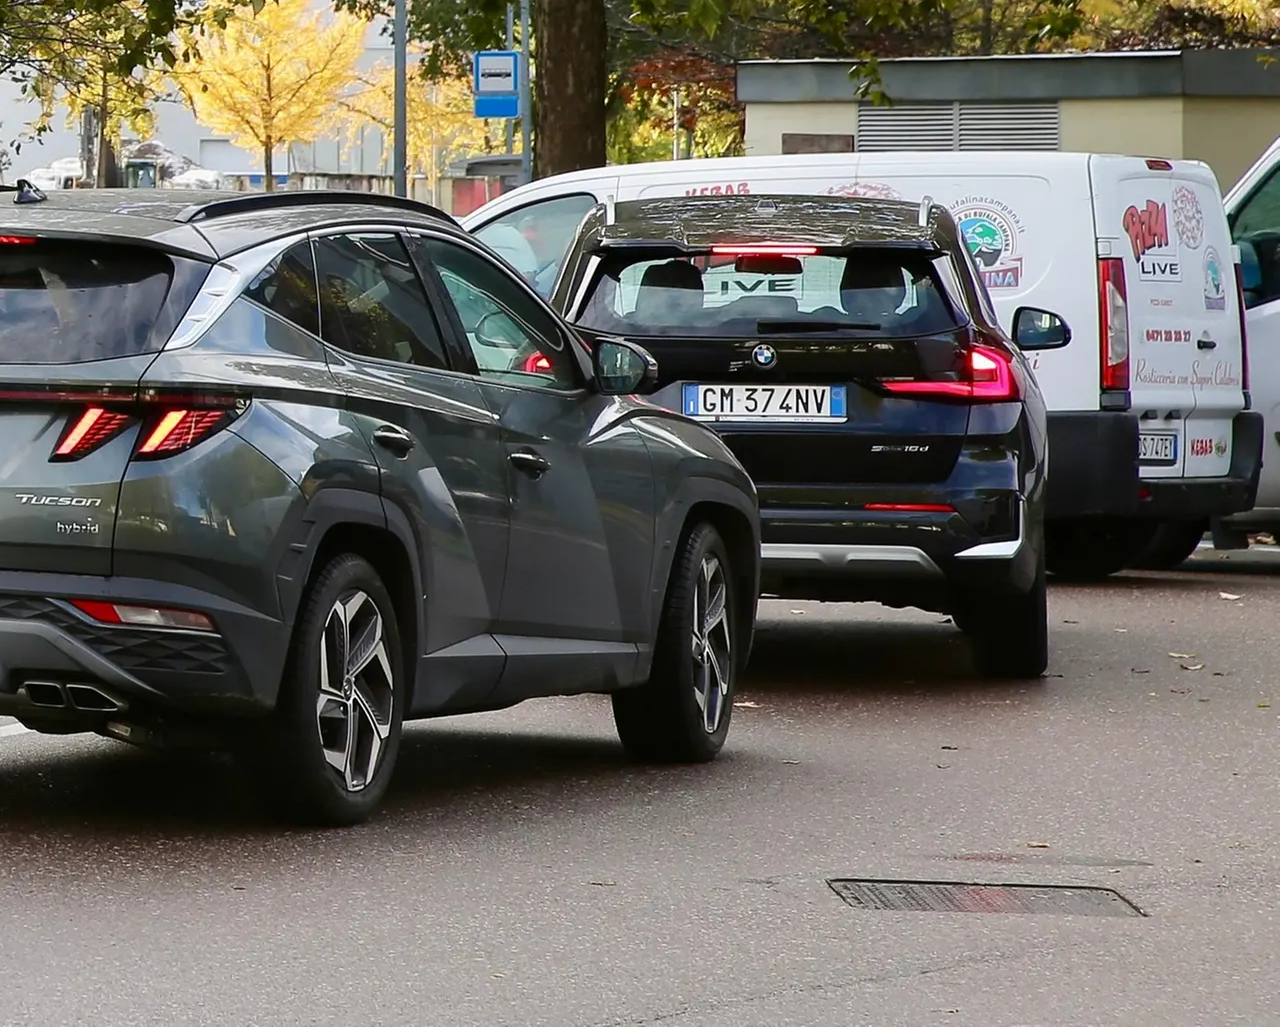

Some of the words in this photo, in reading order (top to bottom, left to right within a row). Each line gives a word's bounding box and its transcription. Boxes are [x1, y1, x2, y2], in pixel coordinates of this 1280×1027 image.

[949, 195, 1025, 235] ufalinacampana.it
[1141, 262, 1180, 276] LIVE
[720, 278, 797, 295] IVE
[702, 387, 734, 413] GM
[744, 388, 827, 414] 374NV
[56, 519, 99, 534] hybrid
